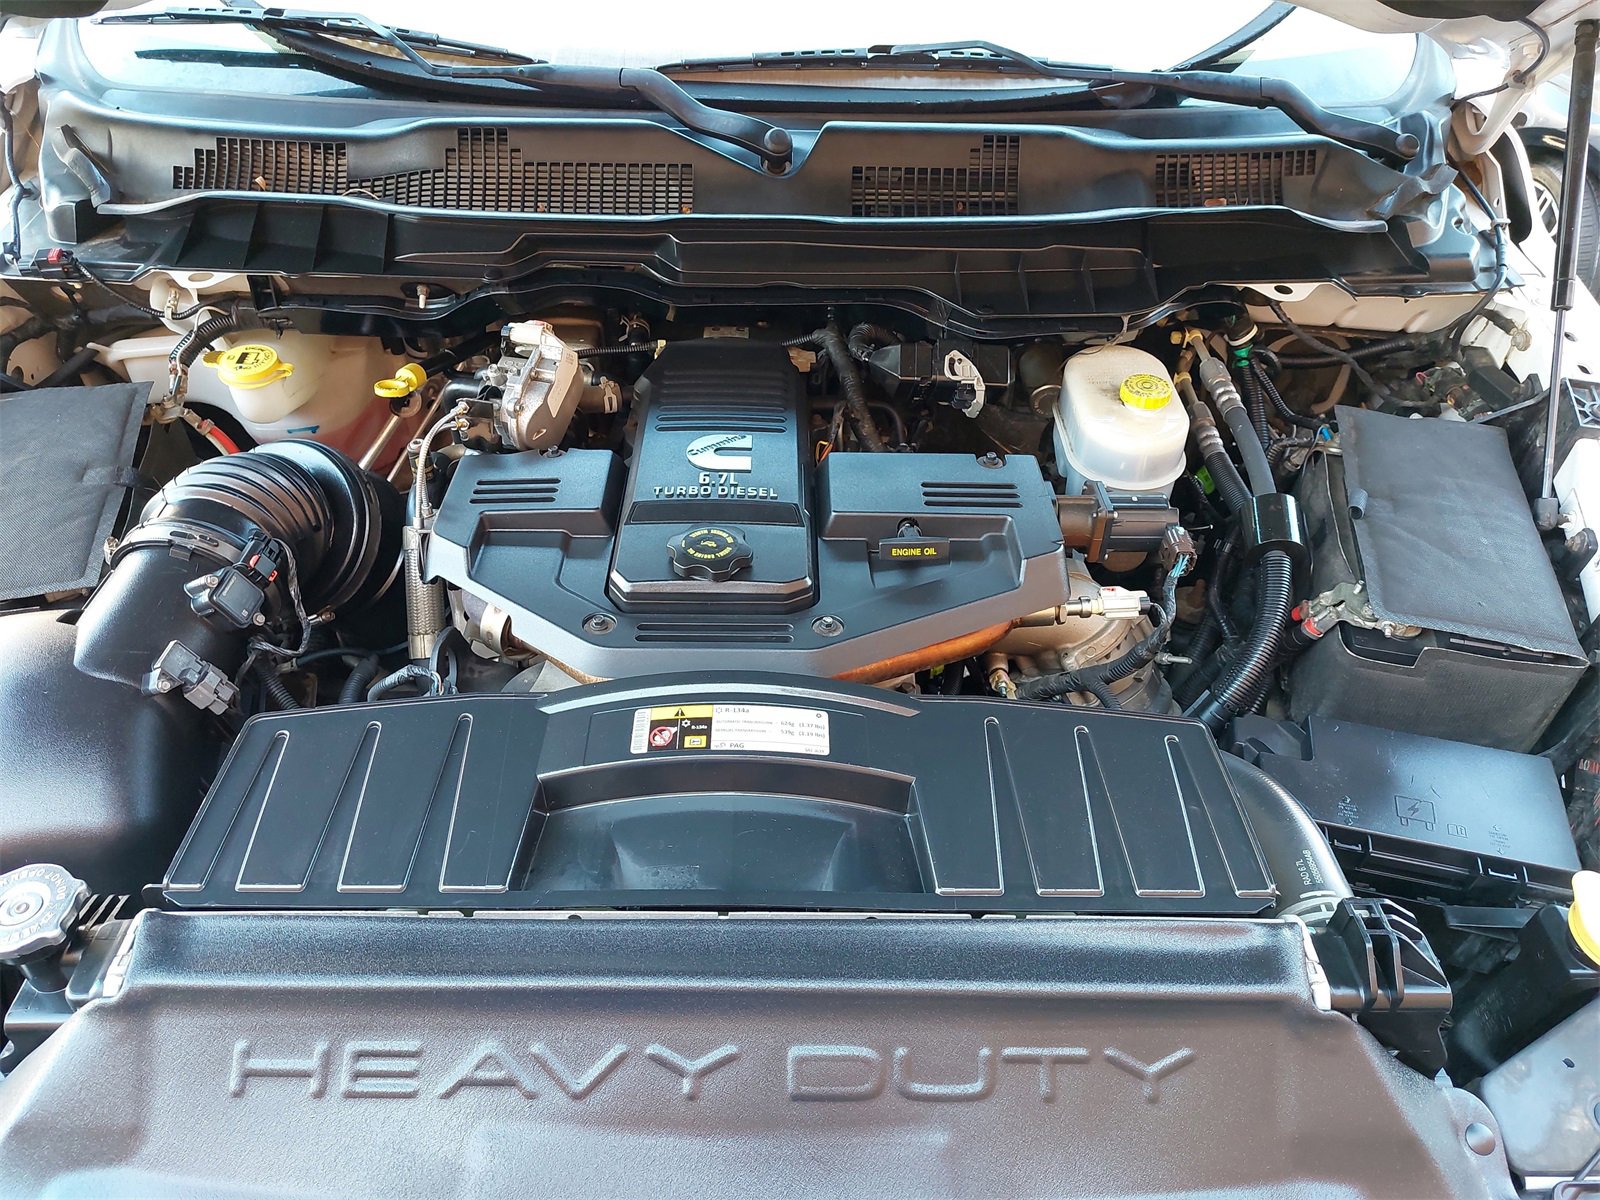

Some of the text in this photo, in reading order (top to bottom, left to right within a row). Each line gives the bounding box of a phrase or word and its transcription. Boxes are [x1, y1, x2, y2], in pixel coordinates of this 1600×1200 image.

[687, 434, 747, 456] Cummins
[698, 472, 738, 487] 6.7L
[654, 486, 778, 499] TURBO DIESEL
[891, 547, 937, 556] ENGINE OIL
[230, 1038, 1196, 1102] HEAVY DUTY
